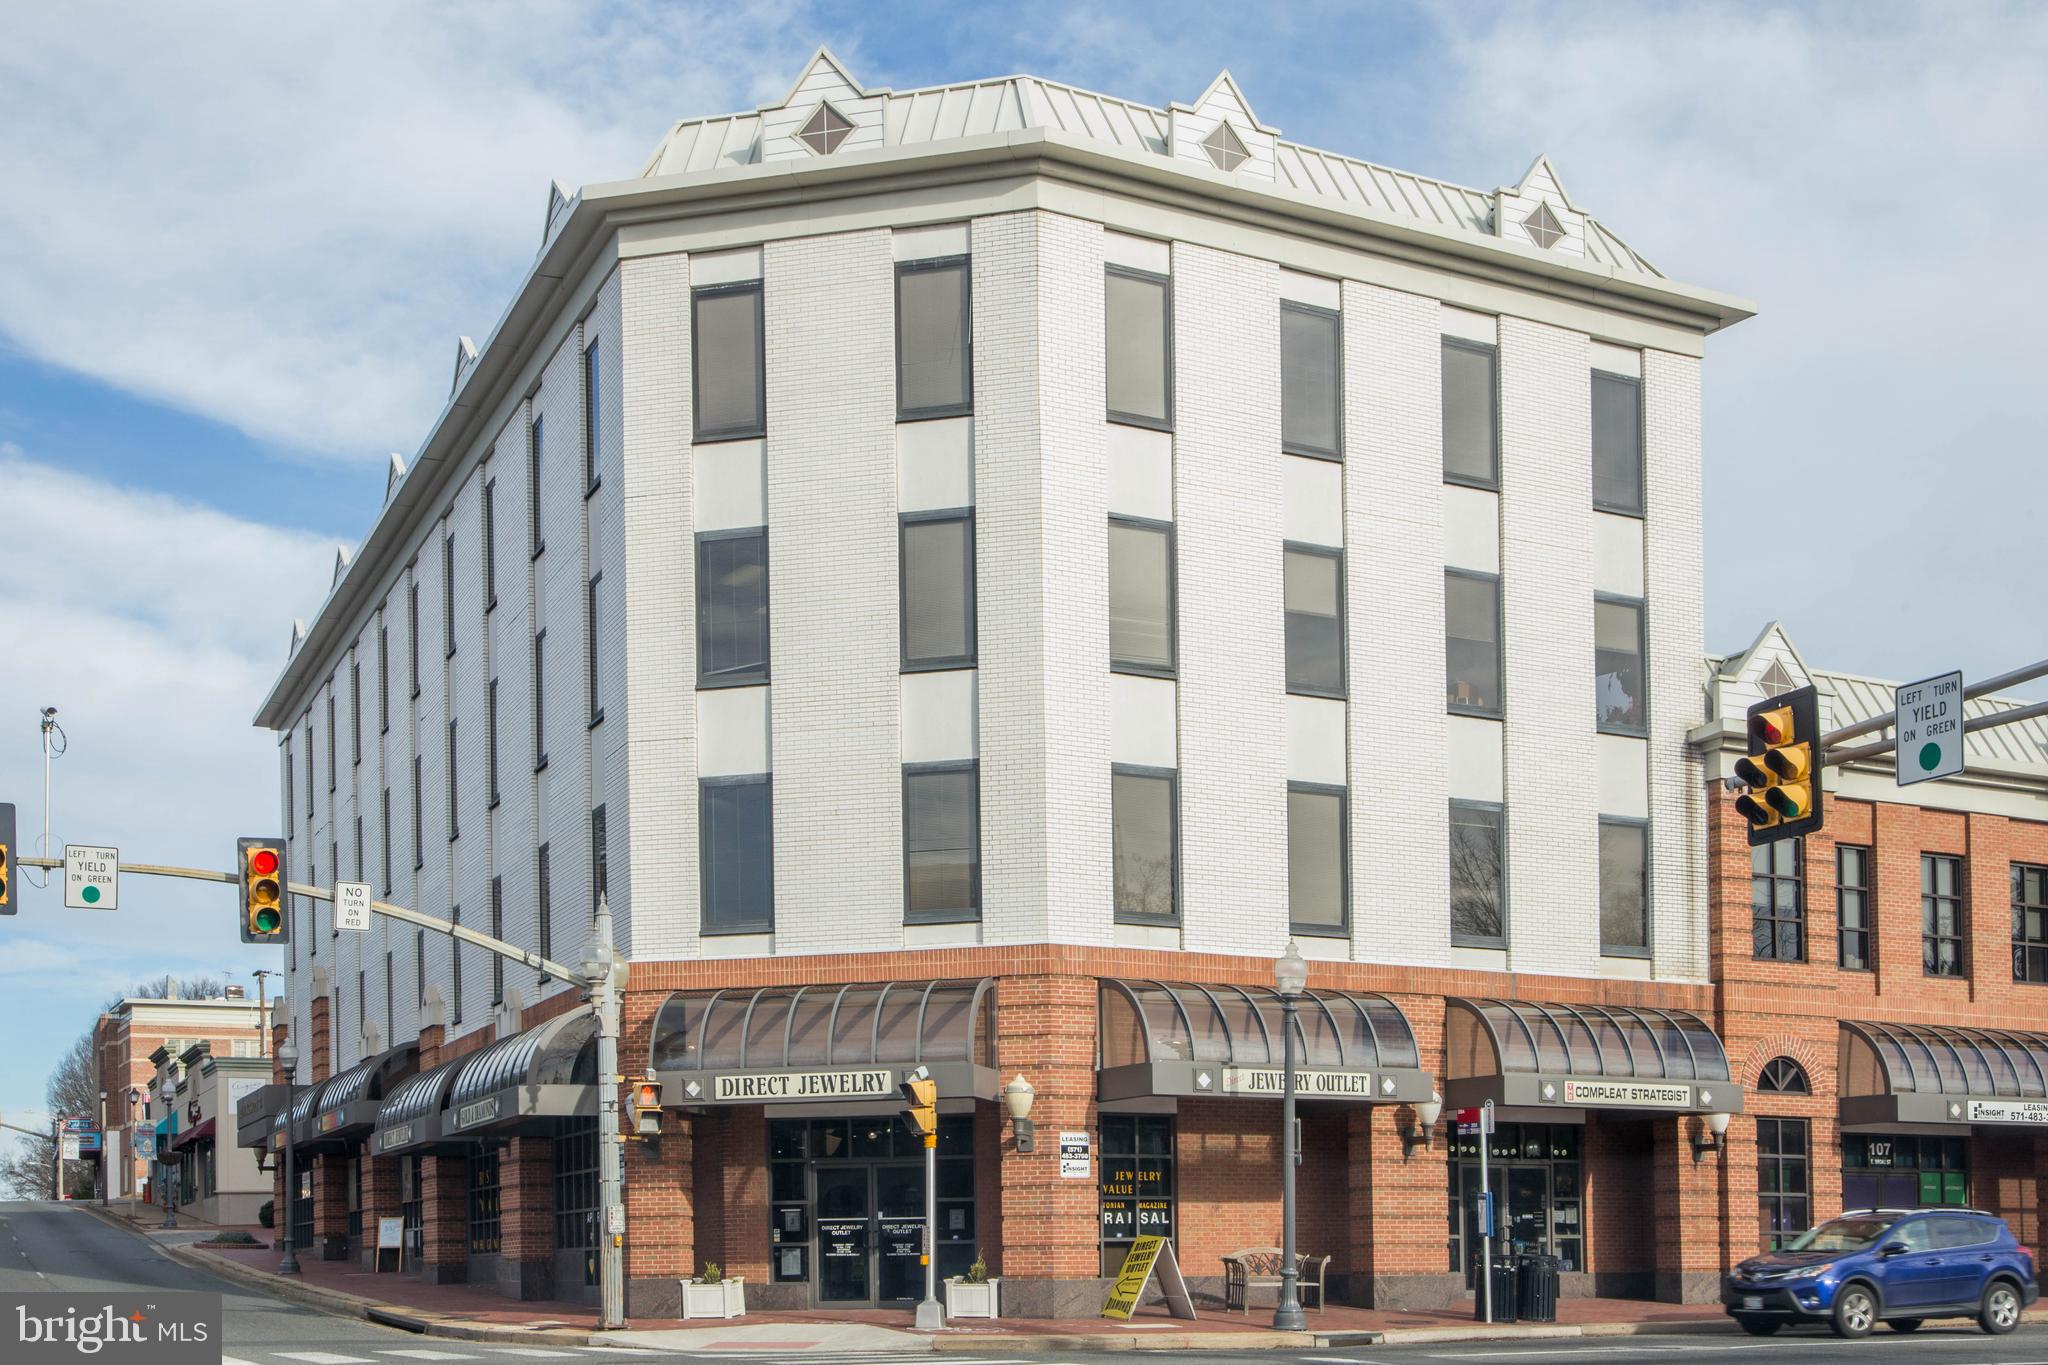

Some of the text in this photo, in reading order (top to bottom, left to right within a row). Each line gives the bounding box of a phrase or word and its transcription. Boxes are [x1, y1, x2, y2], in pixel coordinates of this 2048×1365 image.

[1901, 680, 1957, 706] LEFT TURN
[1912, 701, 1947, 723] YIELD
[1903, 718, 1956, 743] ON GREEN
[68, 850, 116, 860] LEFT TURN
[78, 861, 106, 873] YIELD
[71, 874, 112, 884] ON GREEN
[345, 887, 363, 897] NO
[344, 899, 364, 907] TURN
[345, 918, 361, 927] RED
[721, 1073, 887, 1097] DIRECT JEWELRY
[1248, 1072, 1312, 1091] JEWERY
[1316, 1075, 1367, 1093] OUTLET
[1575, 1086, 1688, 1102] COMPLEAT STRATEGIST
[1977, 1109, 2005, 1117] INSIGHT
[1869, 1143, 1892, 1156] 107
[1133, 1240, 1158, 1252] DIRECT
[1127, 1251, 1155, 1263] JEWELRY
[1125, 1262, 1149, 1273] OUTLET
[1105, 1297, 1133, 1315] DIAMONDS
